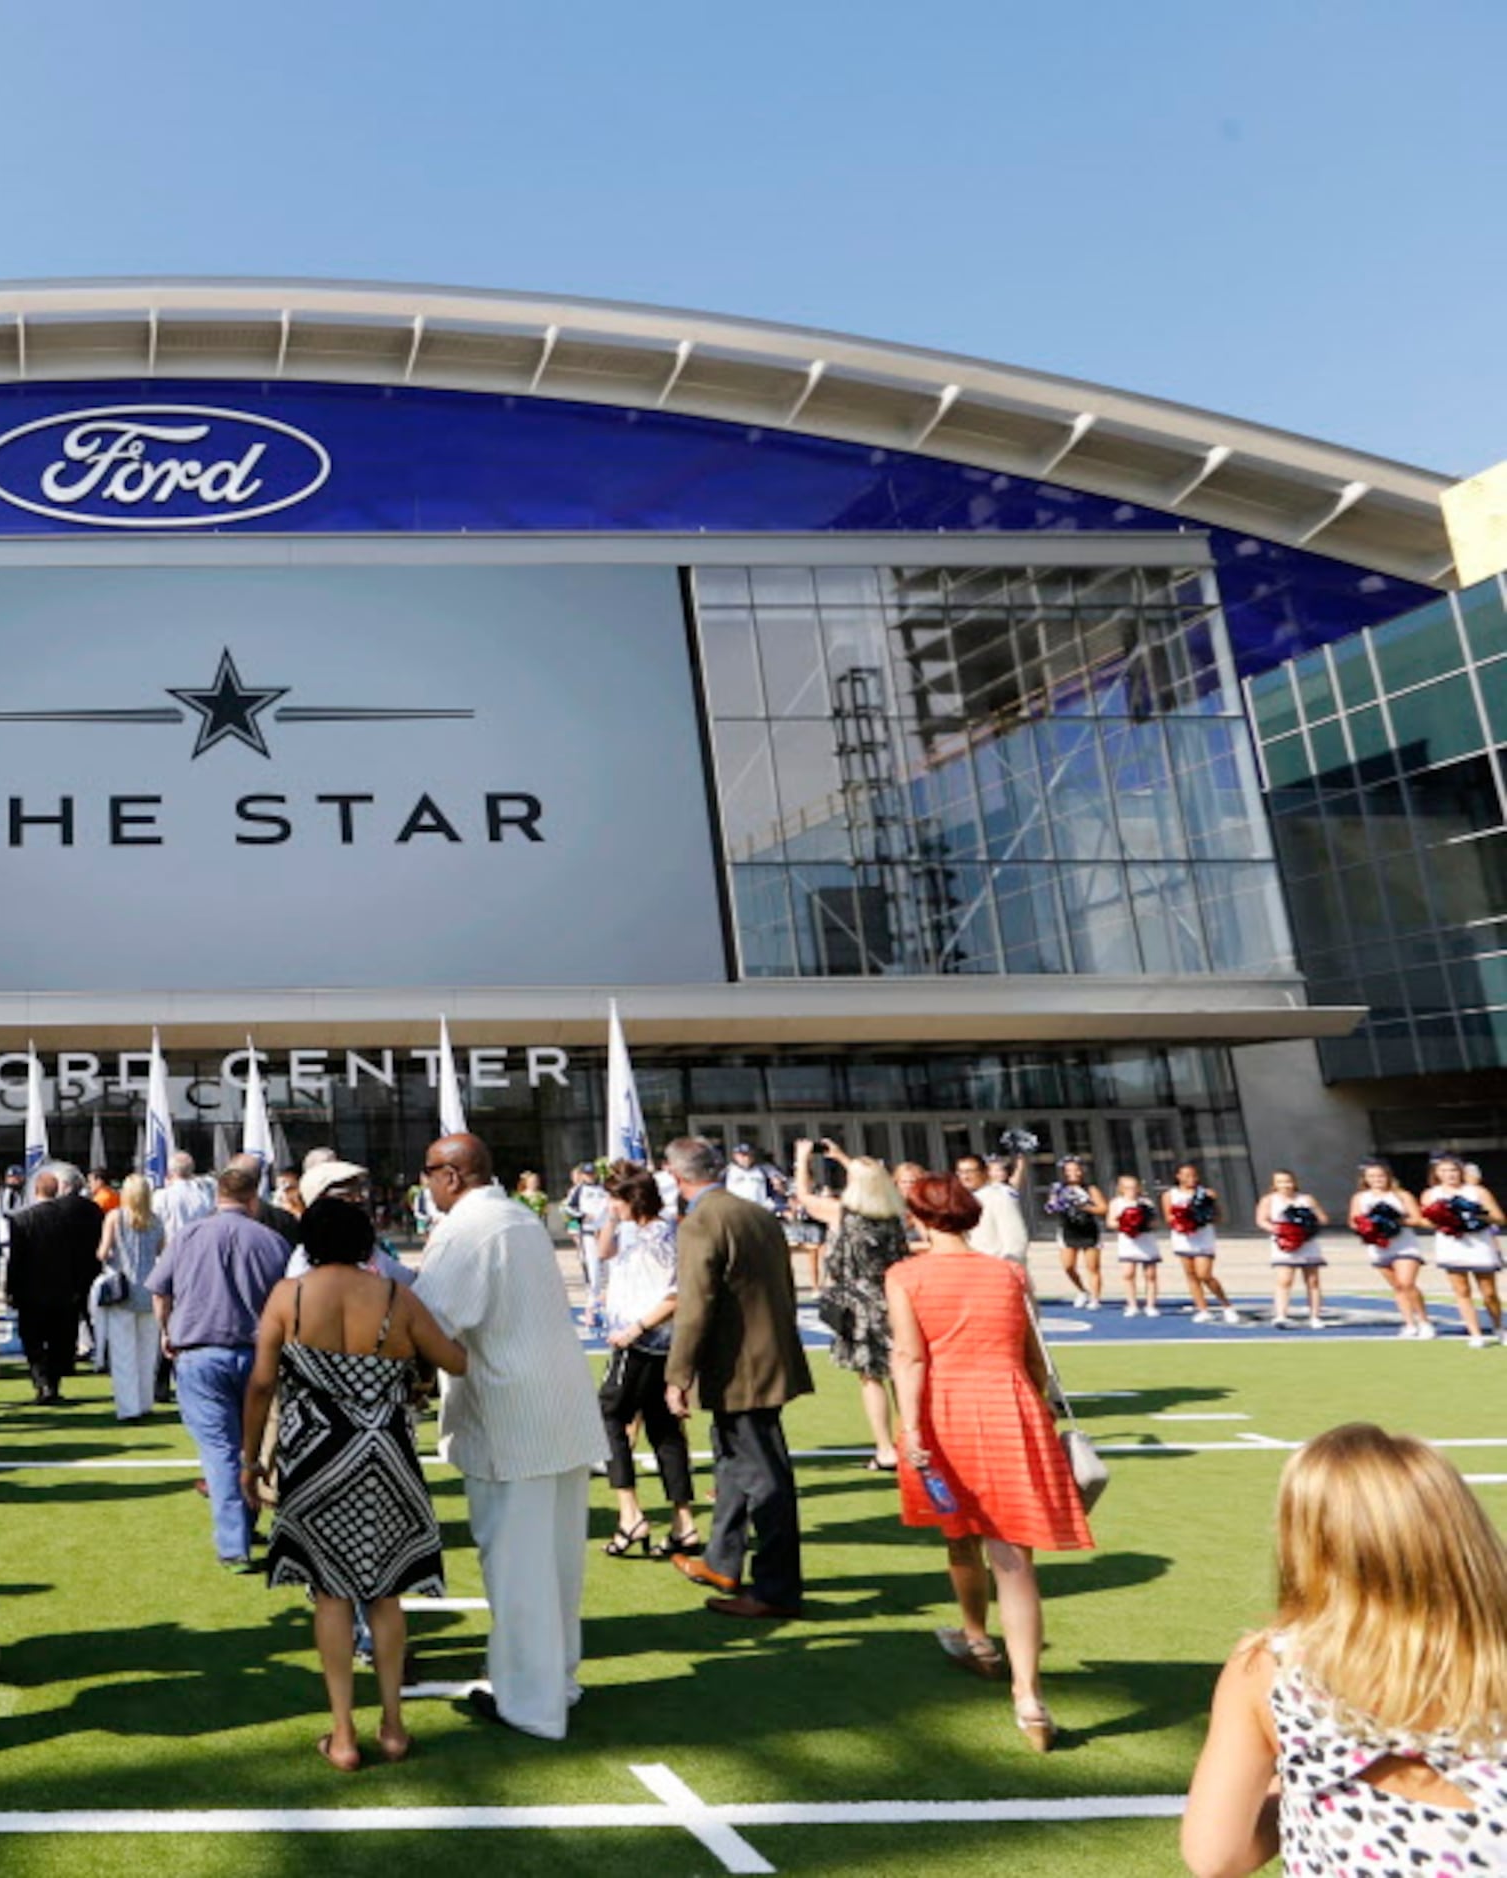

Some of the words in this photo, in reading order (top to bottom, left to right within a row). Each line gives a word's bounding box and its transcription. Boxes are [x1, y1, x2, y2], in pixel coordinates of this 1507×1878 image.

[40, 420, 267, 503] Ford
[234, 791, 546, 846] STAR
[219, 1046, 571, 1090] CENTER
